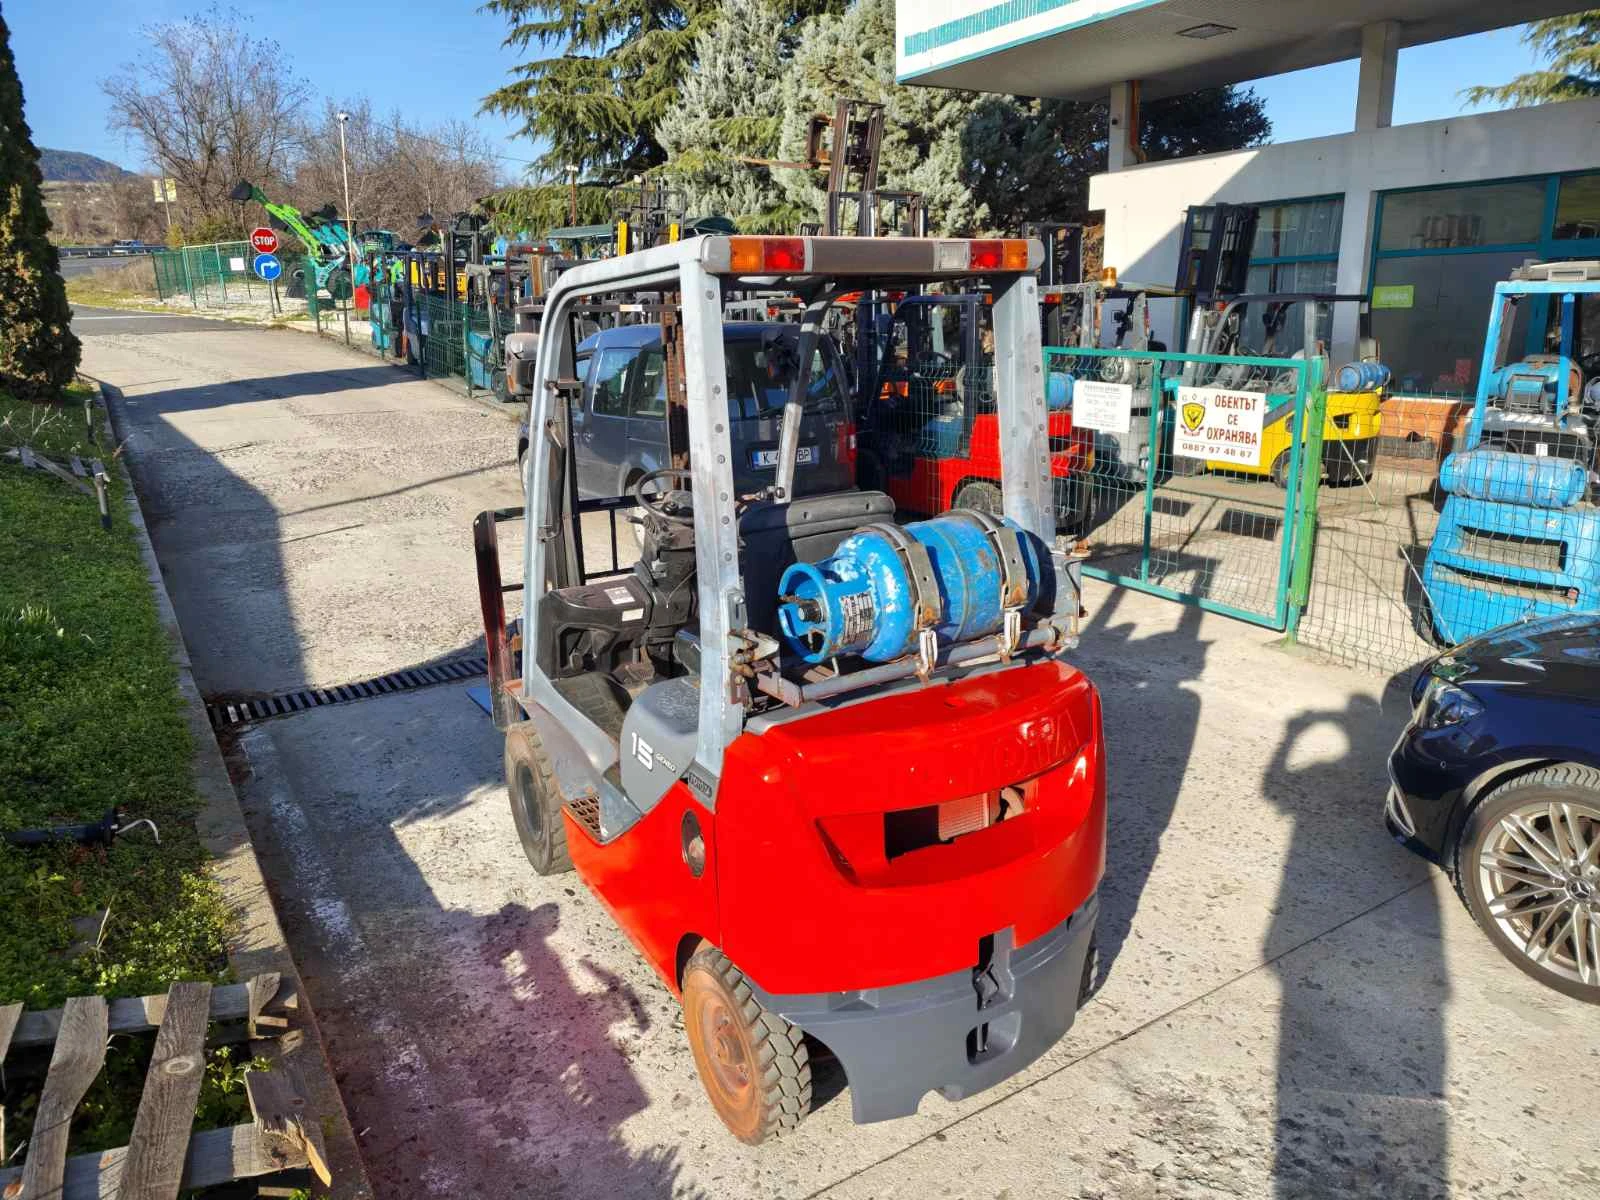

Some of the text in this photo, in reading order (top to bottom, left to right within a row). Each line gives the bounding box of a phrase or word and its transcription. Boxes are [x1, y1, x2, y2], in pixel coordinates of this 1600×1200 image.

[255, 236, 275, 246] STOP
[1215, 395, 1257, 411] ОБЕКТЪТ
[1227, 414, 1239, 426] СЕ
[1206, 427, 1258, 446] ОХРАНЯВА
[1208, 446, 1221, 454] 97
[631, 732, 654, 771] 15
